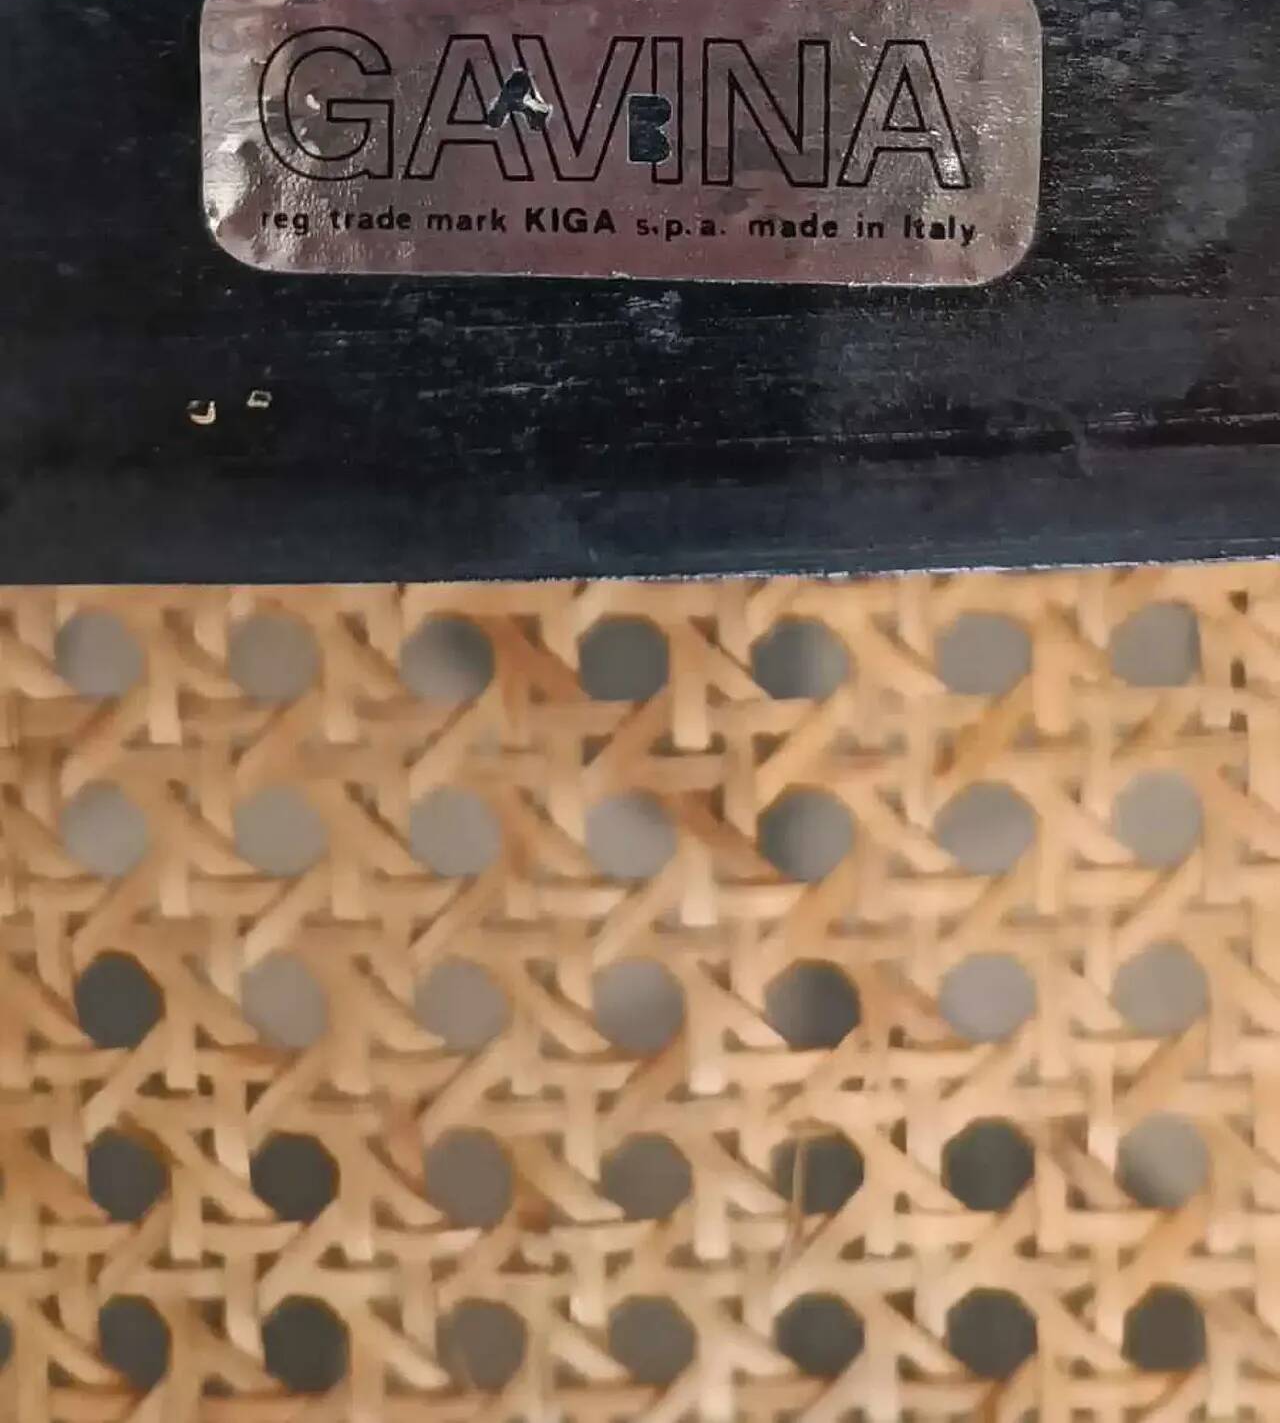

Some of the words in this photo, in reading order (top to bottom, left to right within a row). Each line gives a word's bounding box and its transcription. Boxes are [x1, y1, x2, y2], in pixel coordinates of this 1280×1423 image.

[258, 26, 972, 190] GAVINA
[261, 211, 309, 235] reg
[329, 205, 412, 230] trade
[426, 208, 507, 232] mark
[525, 207, 617, 234] KIGA
[749, 212, 839, 239] made
[856, 212, 885, 239] in
[903, 214, 976, 247] Italy
